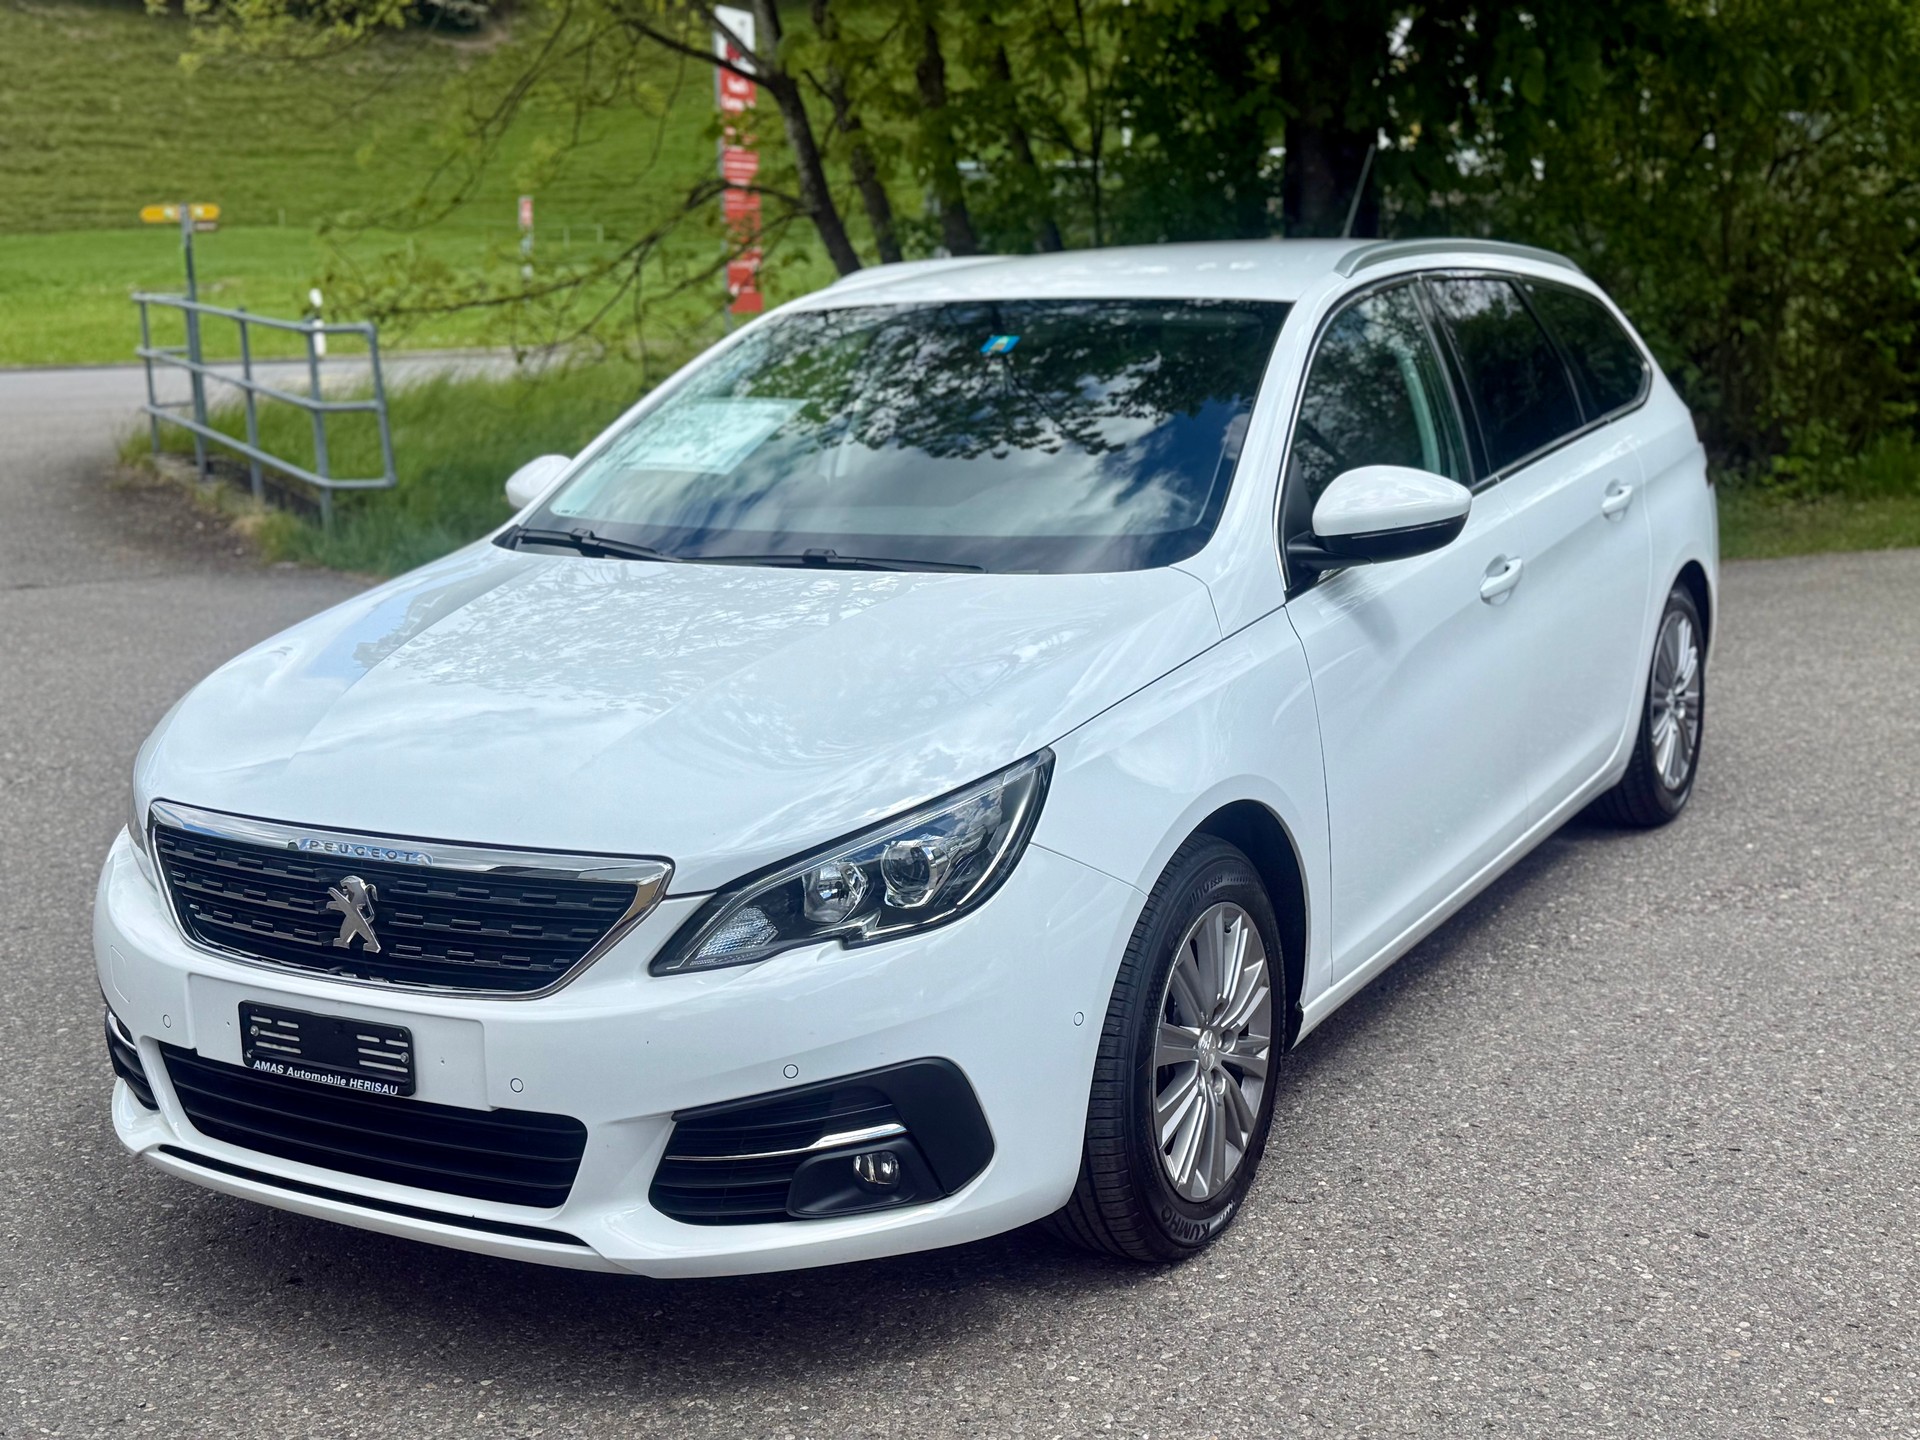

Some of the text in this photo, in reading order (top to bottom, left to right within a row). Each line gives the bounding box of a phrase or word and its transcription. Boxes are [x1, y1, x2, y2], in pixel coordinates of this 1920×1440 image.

[309, 840, 413, 862] PEUGEOT
[253, 1060, 399, 1095] AMAS Automobile HERISAU
[1161, 1206, 1211, 1240] KUMHO
